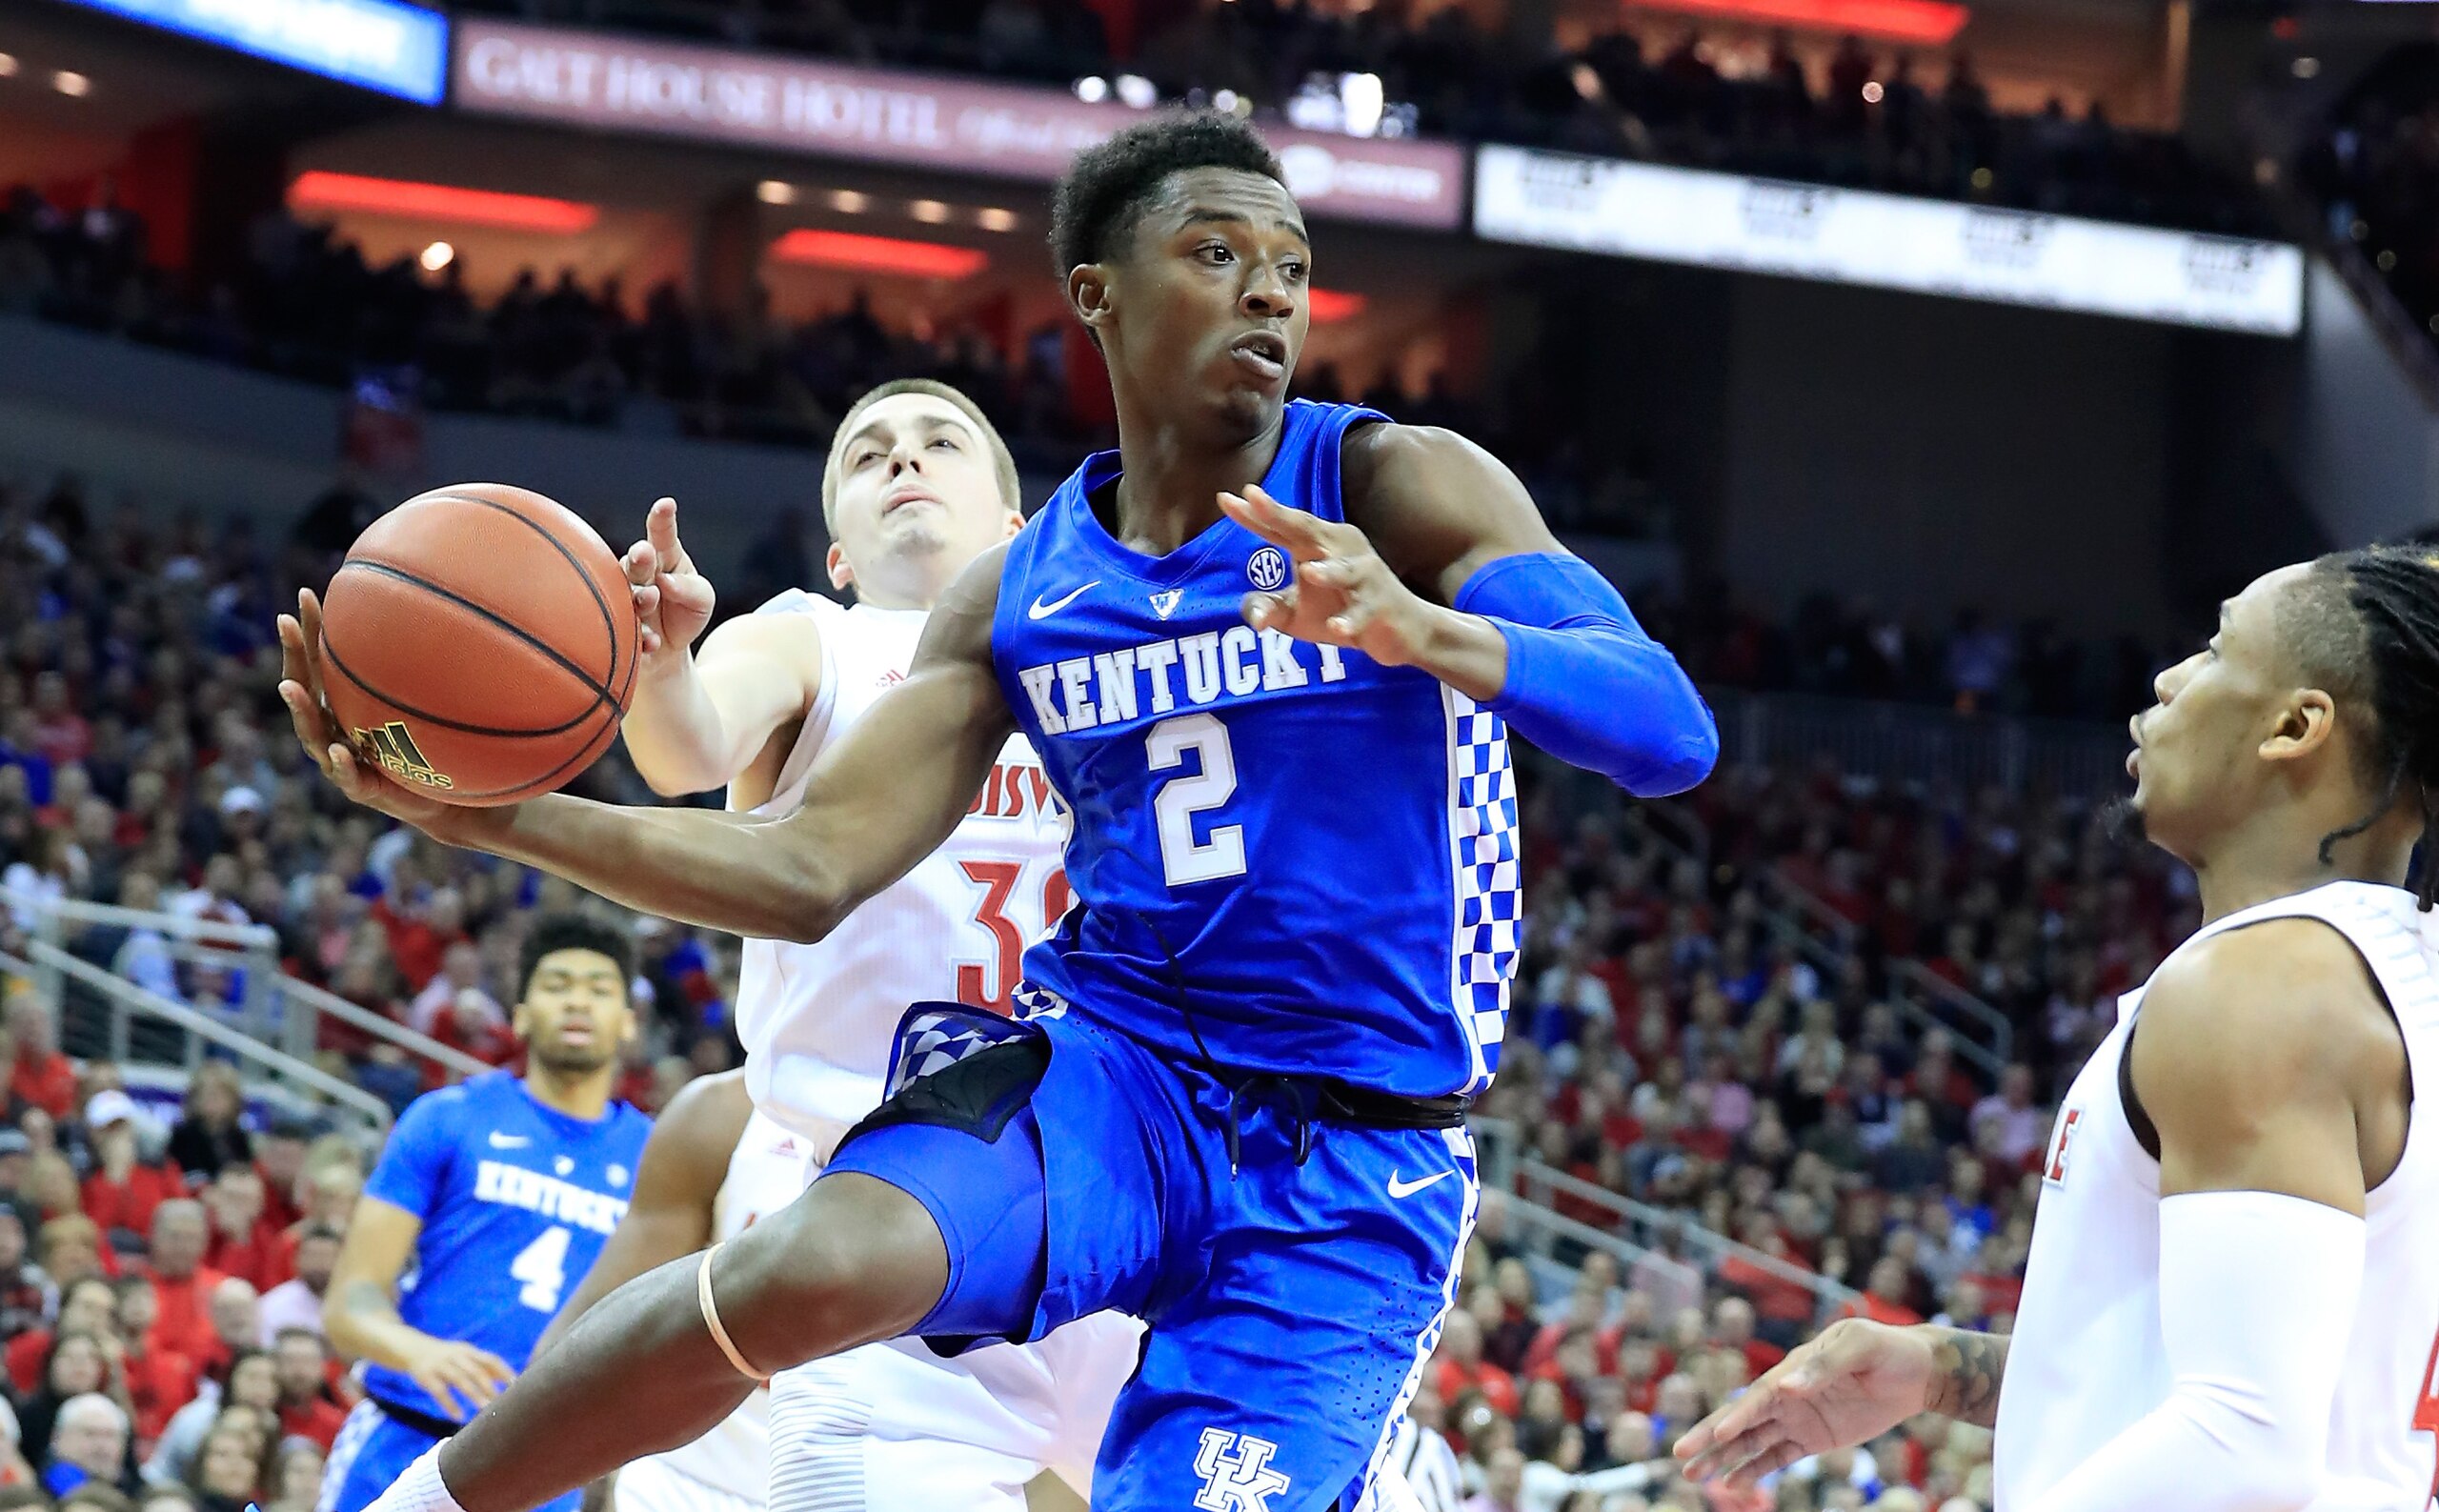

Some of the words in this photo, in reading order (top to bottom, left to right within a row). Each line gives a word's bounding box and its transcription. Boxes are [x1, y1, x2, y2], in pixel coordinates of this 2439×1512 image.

[606, 54, 771, 127] HOUSE
[783, 76, 949, 150] HOTEL
[1249, 551, 1283, 588] SEC
[1018, 625, 1346, 736] KENTUCKY
[1145, 713, 1246, 887] 2
[474, 1159, 630, 1237] KENTUCK
[511, 1224, 572, 1314] 4
[1193, 1427, 1291, 1512] UK
